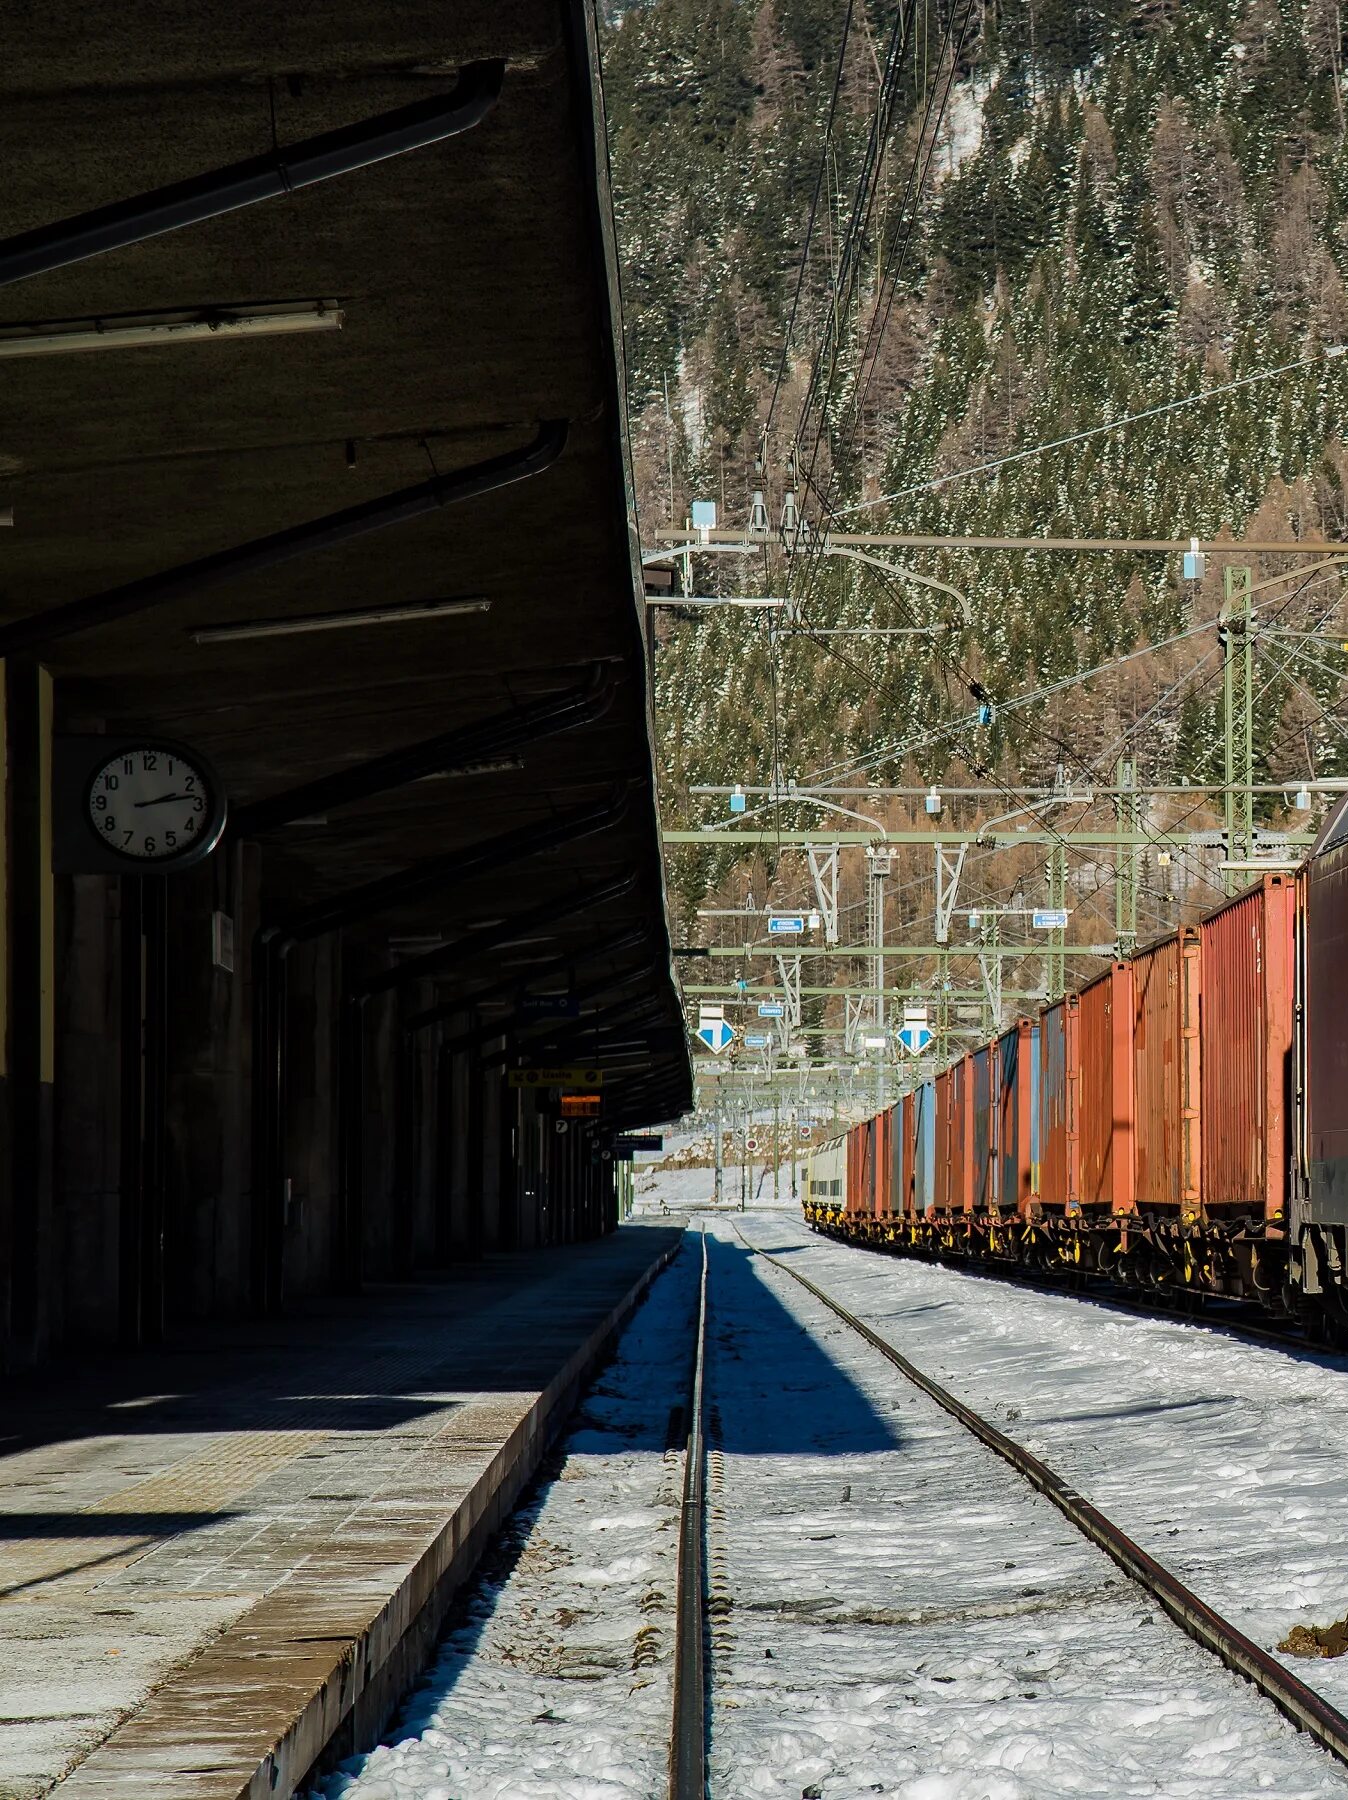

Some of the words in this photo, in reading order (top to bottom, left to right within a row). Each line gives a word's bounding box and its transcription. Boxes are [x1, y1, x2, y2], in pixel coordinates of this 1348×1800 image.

[124, 760, 133, 775] 11
[143, 755, 157, 771] 12
[169, 760, 173, 776] 1
[104, 775, 118, 790] 10
[185, 776, 194, 792] 2
[96, 795, 106, 810] 9
[193, 796, 203, 812] 3
[105, 816, 115, 831] 8
[184, 817, 194, 832] 4
[123, 831, 134, 845] 7
[145, 837, 155, 852] 6
[166, 831, 176, 847] 5
